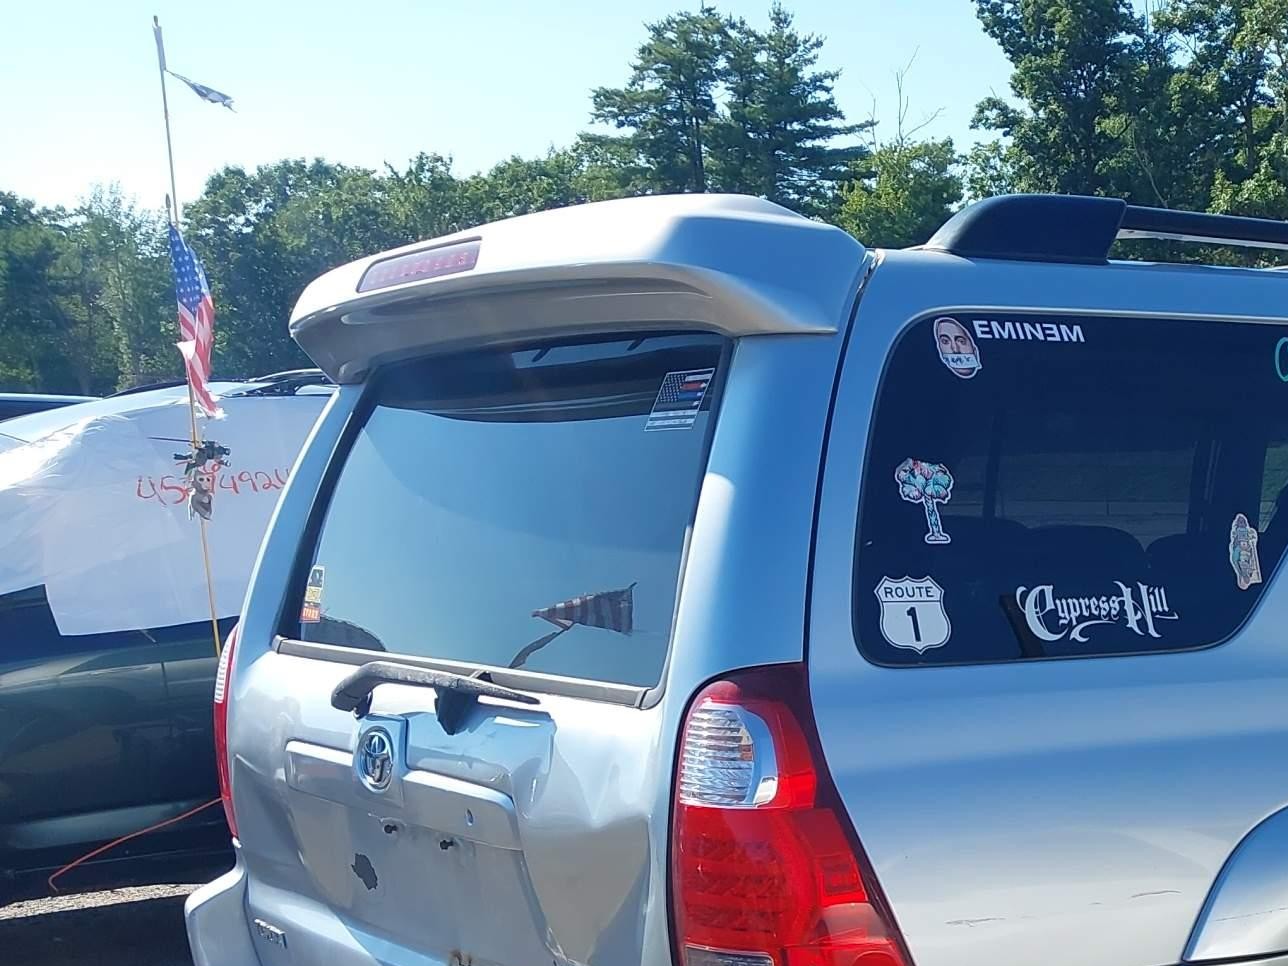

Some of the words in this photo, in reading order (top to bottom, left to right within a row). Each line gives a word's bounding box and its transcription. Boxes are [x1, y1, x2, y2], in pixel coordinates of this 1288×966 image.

[972, 320, 1086, 343] EMINEM
[884, 585, 934, 598] ROUTE
[906, 606, 922, 642] 1
[1016, 584, 1122, 643] Cypress
[1113, 580, 1179, 638] Hill
